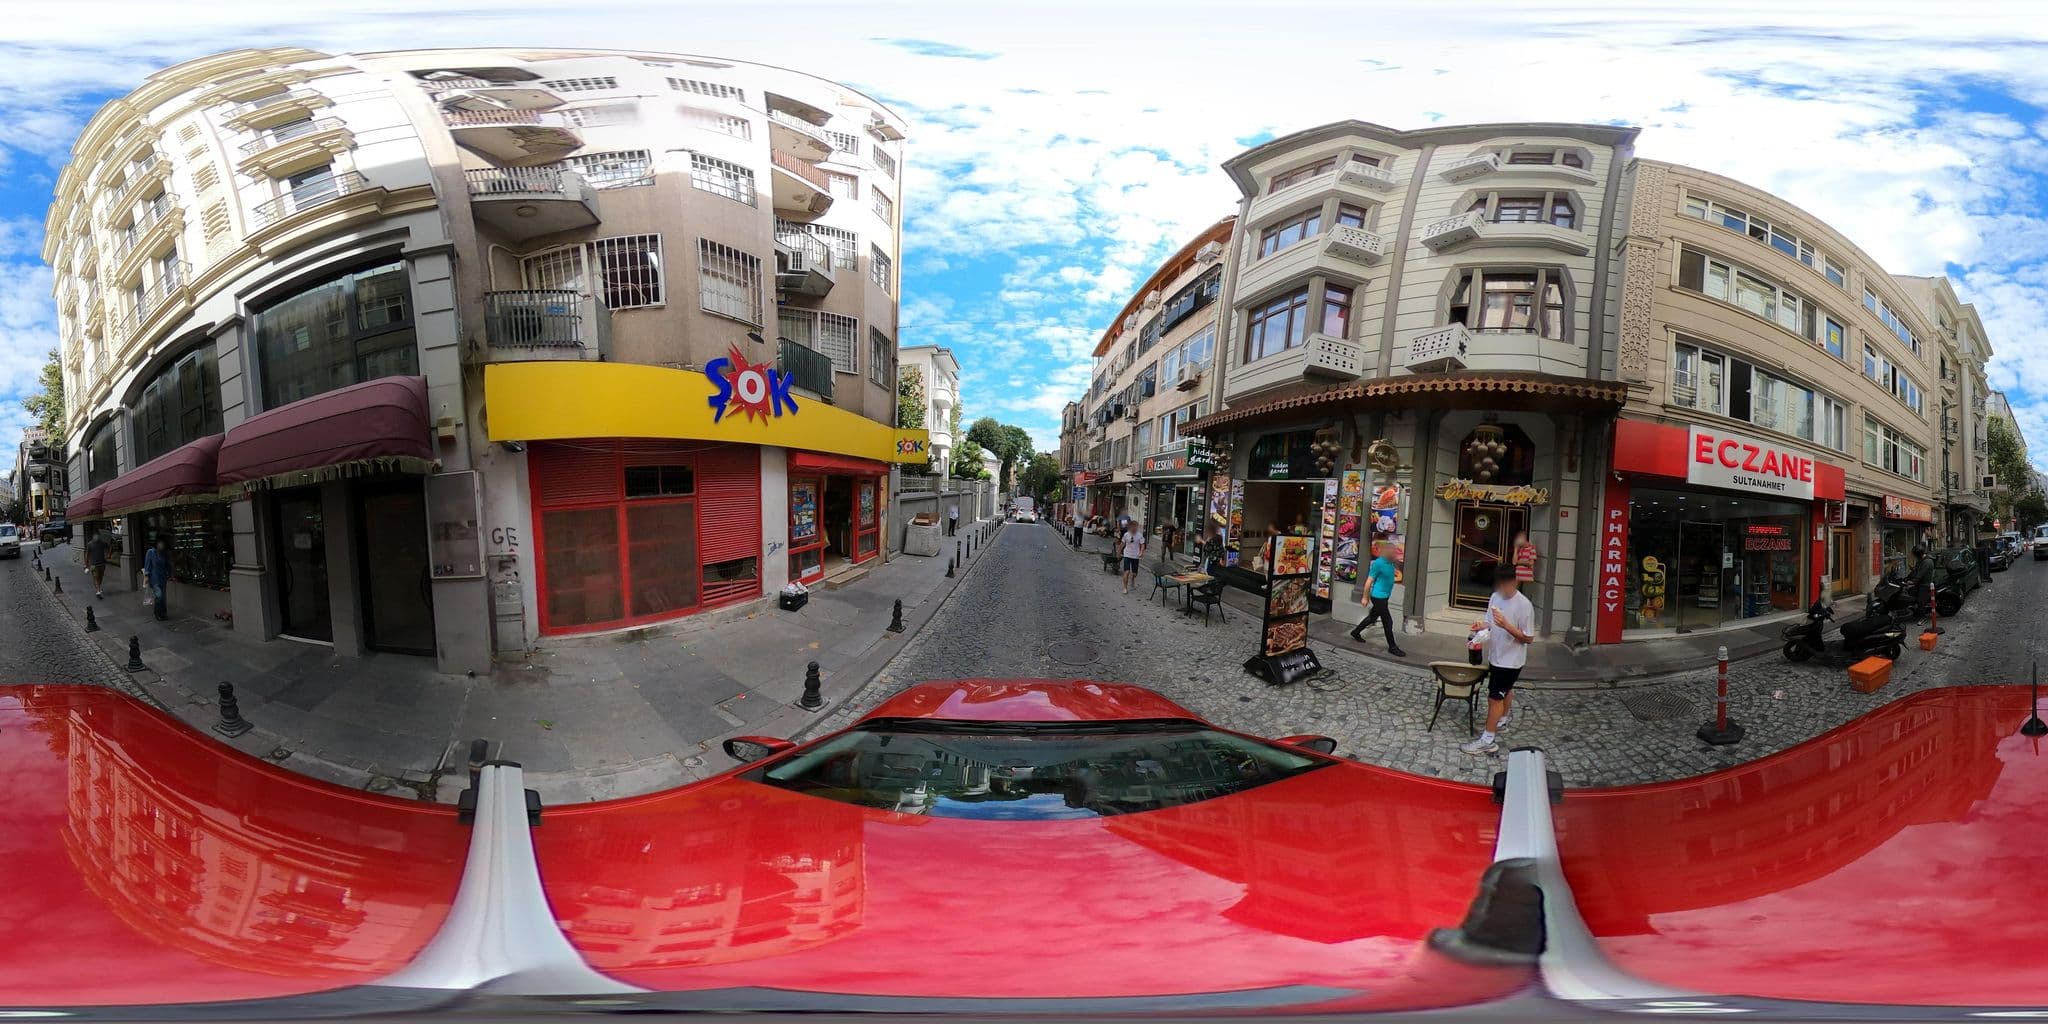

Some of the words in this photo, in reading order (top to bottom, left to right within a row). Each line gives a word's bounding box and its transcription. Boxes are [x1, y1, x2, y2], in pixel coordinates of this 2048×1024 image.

[705, 357, 799, 424] ŞOK
[896, 440, 924, 455] ŞOK
[1695, 433, 1812, 482] ECZANE
[1732, 475, 1786, 491] SULTANAHMET
[1604, 509, 1622, 612] PHARMACY
